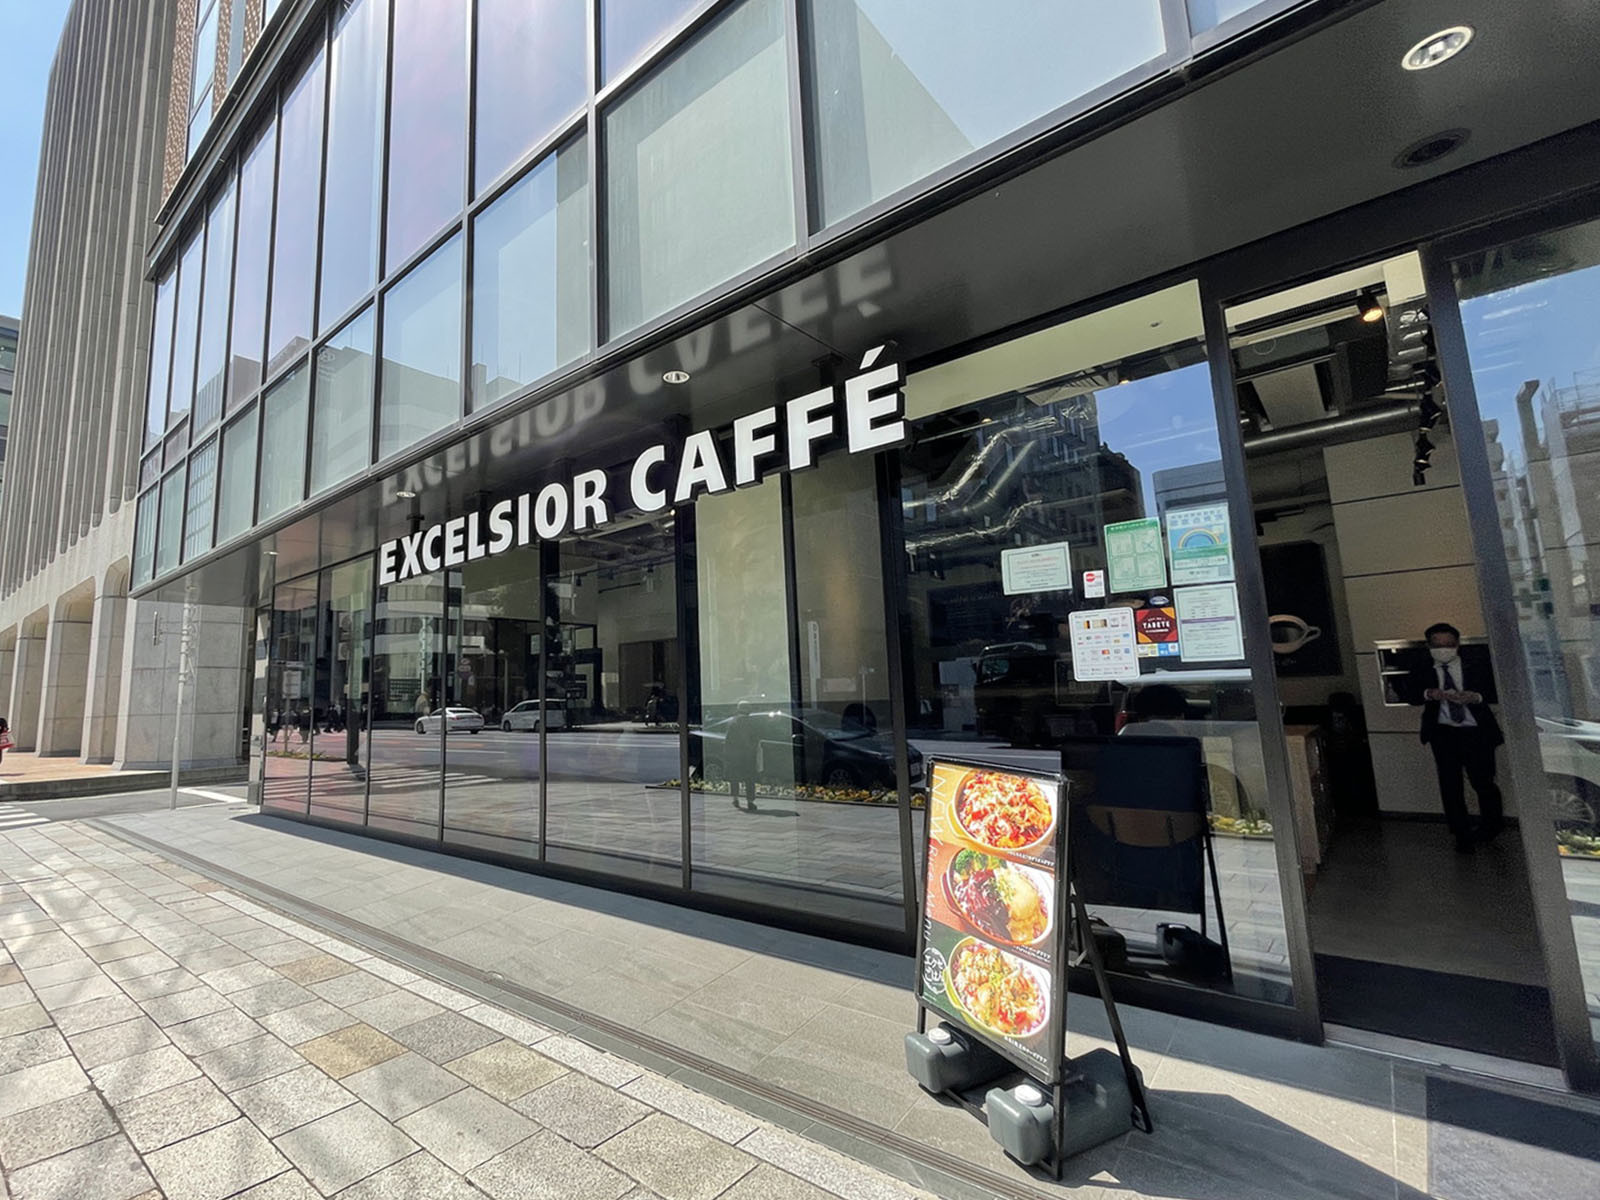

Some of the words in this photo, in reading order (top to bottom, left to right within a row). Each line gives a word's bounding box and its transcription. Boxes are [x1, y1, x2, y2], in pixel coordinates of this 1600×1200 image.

[379, 468, 608, 586] EXCELSIOR
[630, 344, 905, 512] CAFFÉ
[931, 774, 947, 846] NEW
